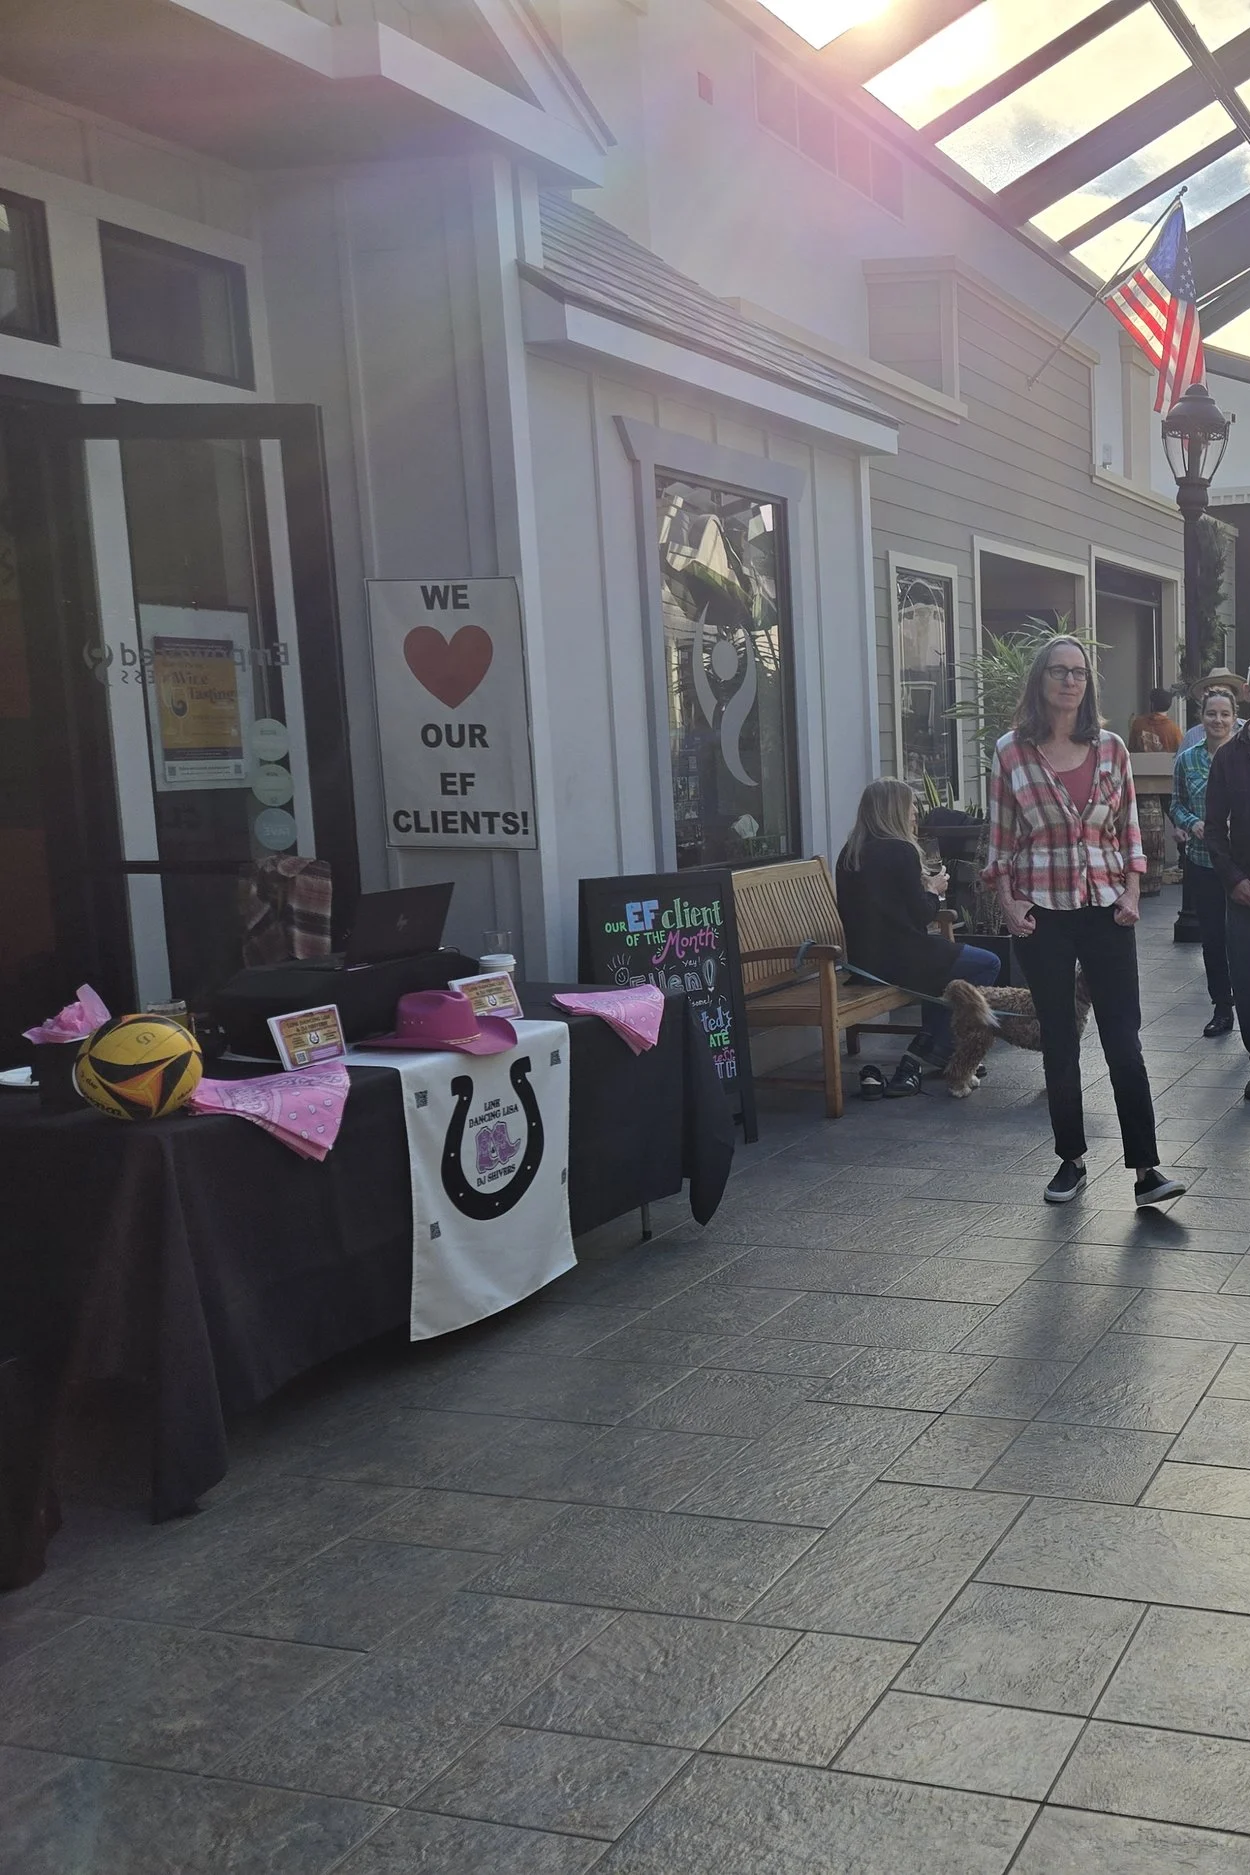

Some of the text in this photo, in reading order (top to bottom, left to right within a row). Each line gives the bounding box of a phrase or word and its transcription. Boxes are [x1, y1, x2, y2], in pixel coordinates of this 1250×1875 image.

[420, 584, 470, 611] WE
[420, 723, 490, 749] OUR
[439, 772, 476, 796] EF
[392, 810, 530, 836] CLIENTS!
[604, 897, 724, 934] OUR EF client
[626, 925, 717, 965] OF THE Month
[468, 1103, 519, 1129] DANCING LISA
[484, 1098, 502, 1112] LINE
[476, 1163, 516, 1188] DJ SHIVERS
